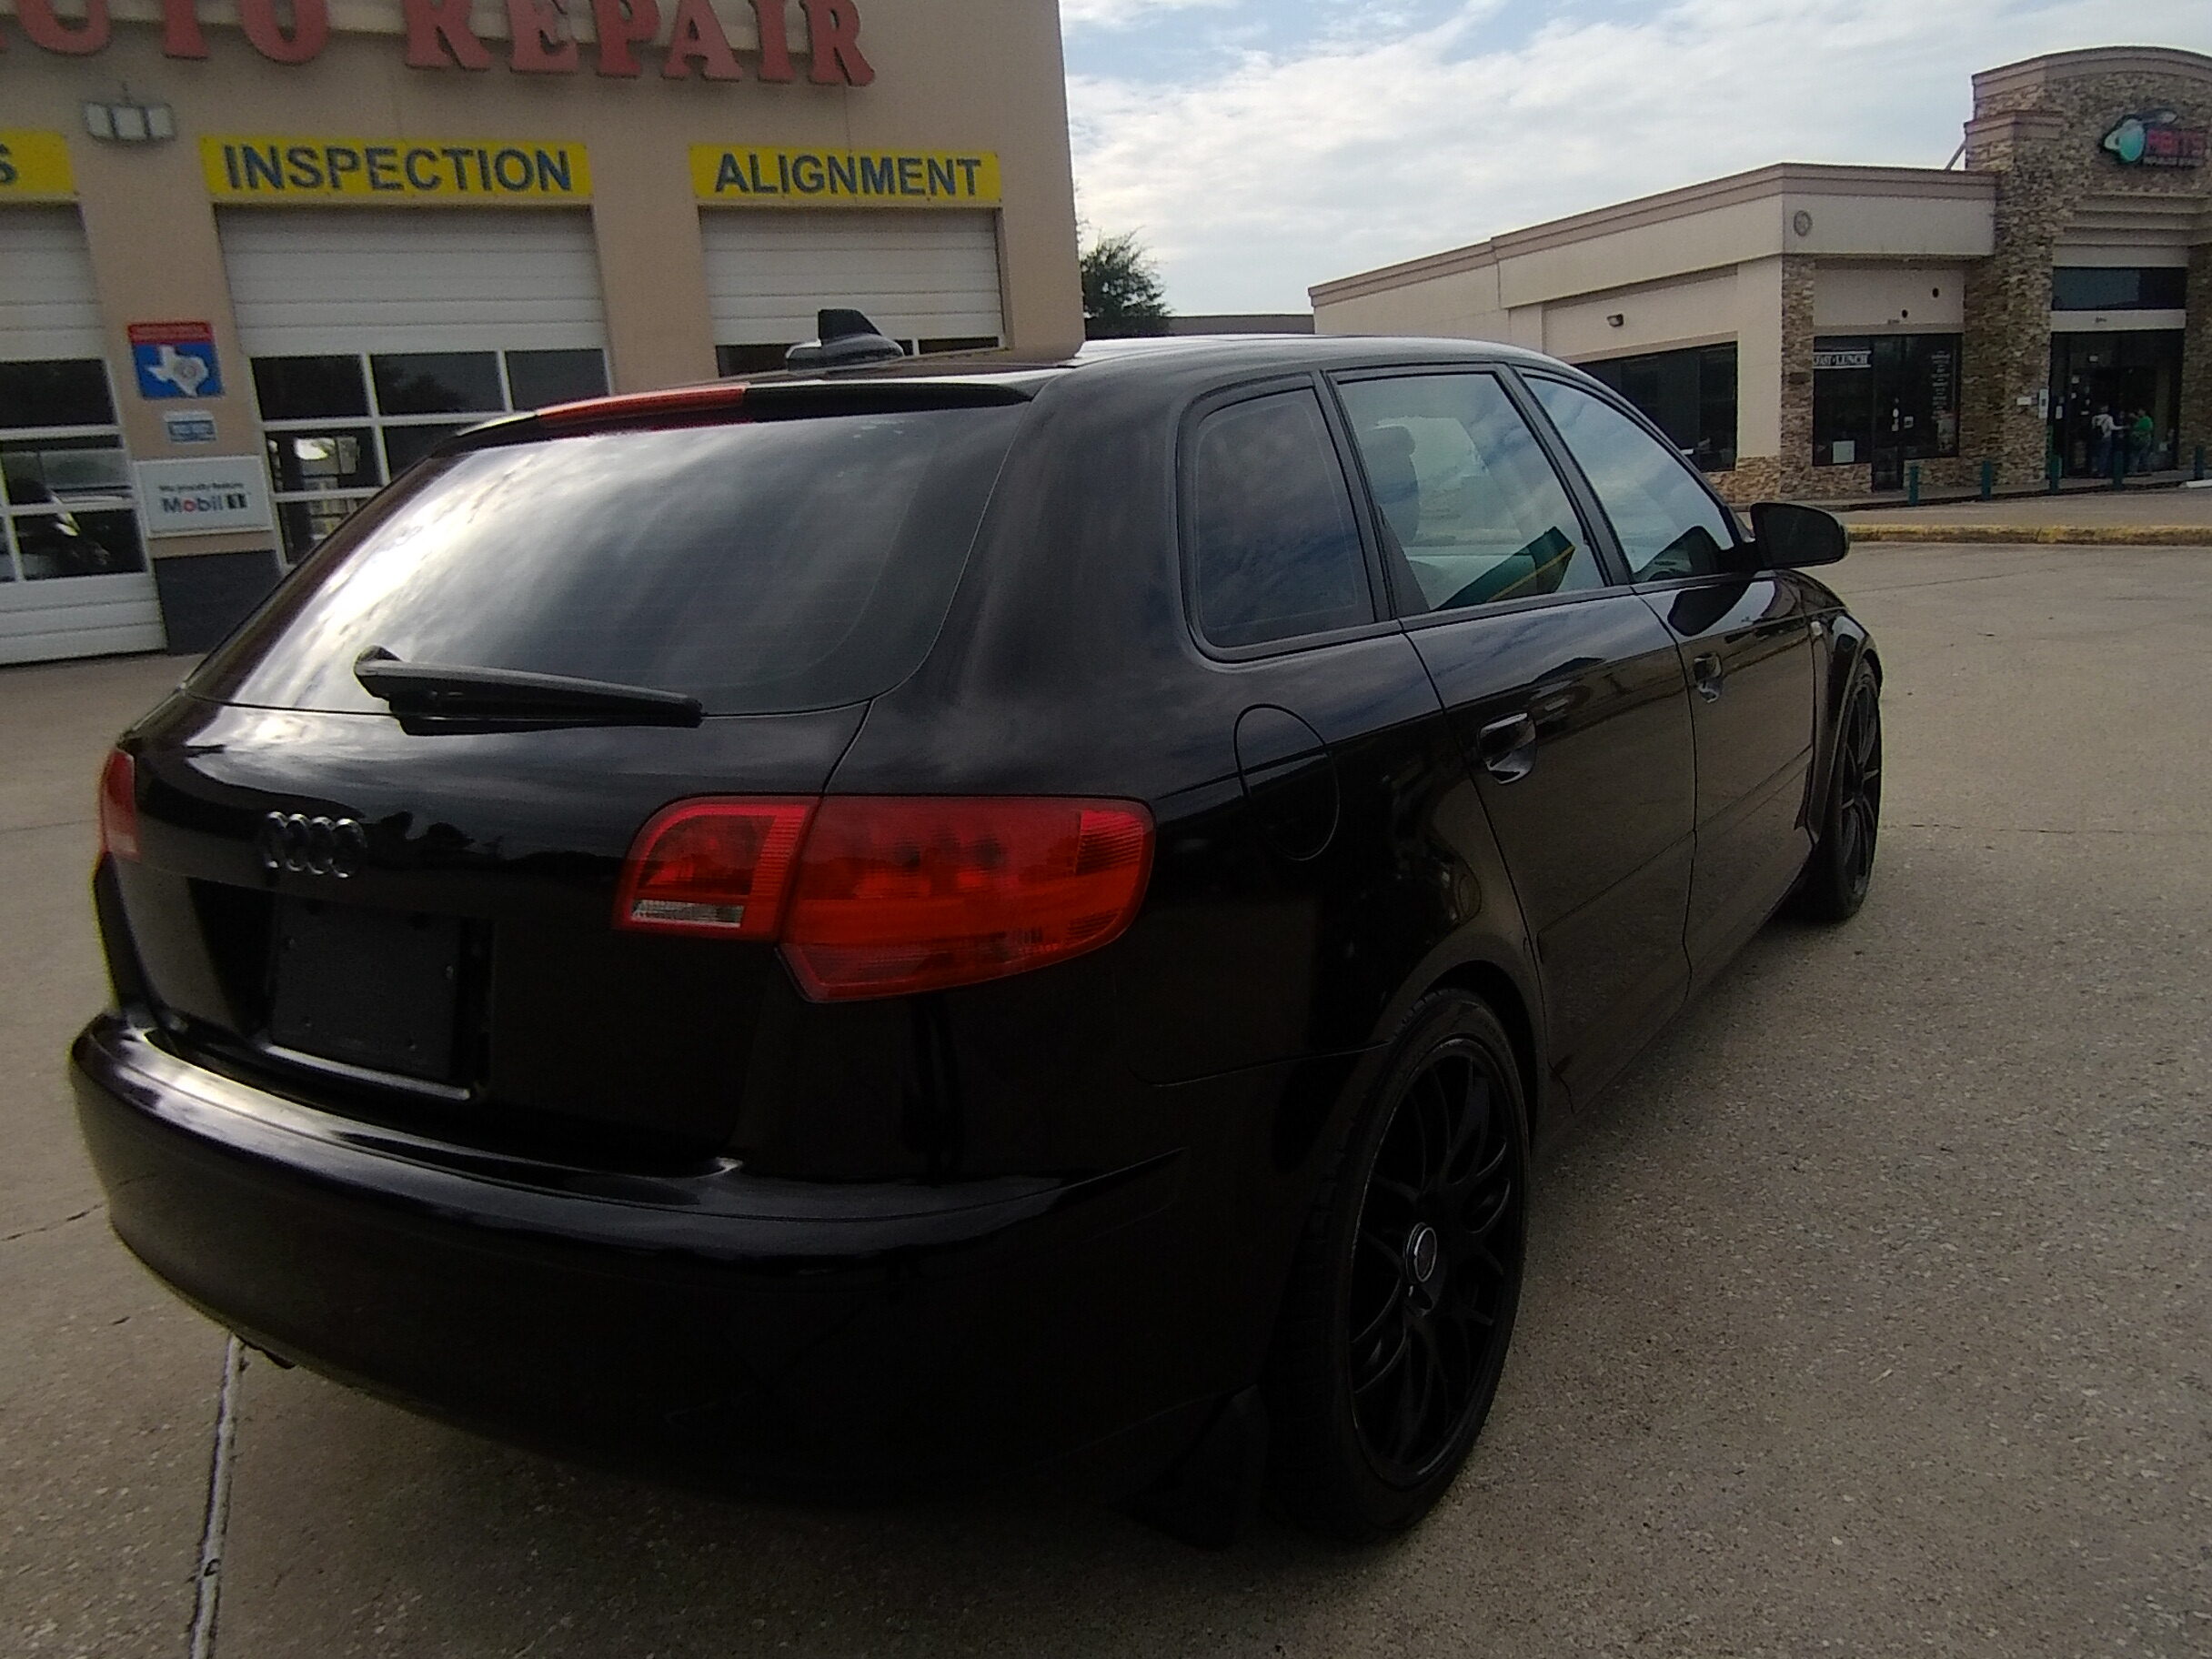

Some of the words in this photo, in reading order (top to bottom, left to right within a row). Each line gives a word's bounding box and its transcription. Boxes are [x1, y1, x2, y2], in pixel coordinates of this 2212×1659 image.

[0, 0, 330, 65] UTO
[403, 0, 876, 86] REPAIR
[223, 144, 572, 192] INSPECTION
[715, 152, 982, 196] ALIGNMENT
[161, 494, 224, 513] Mobil
